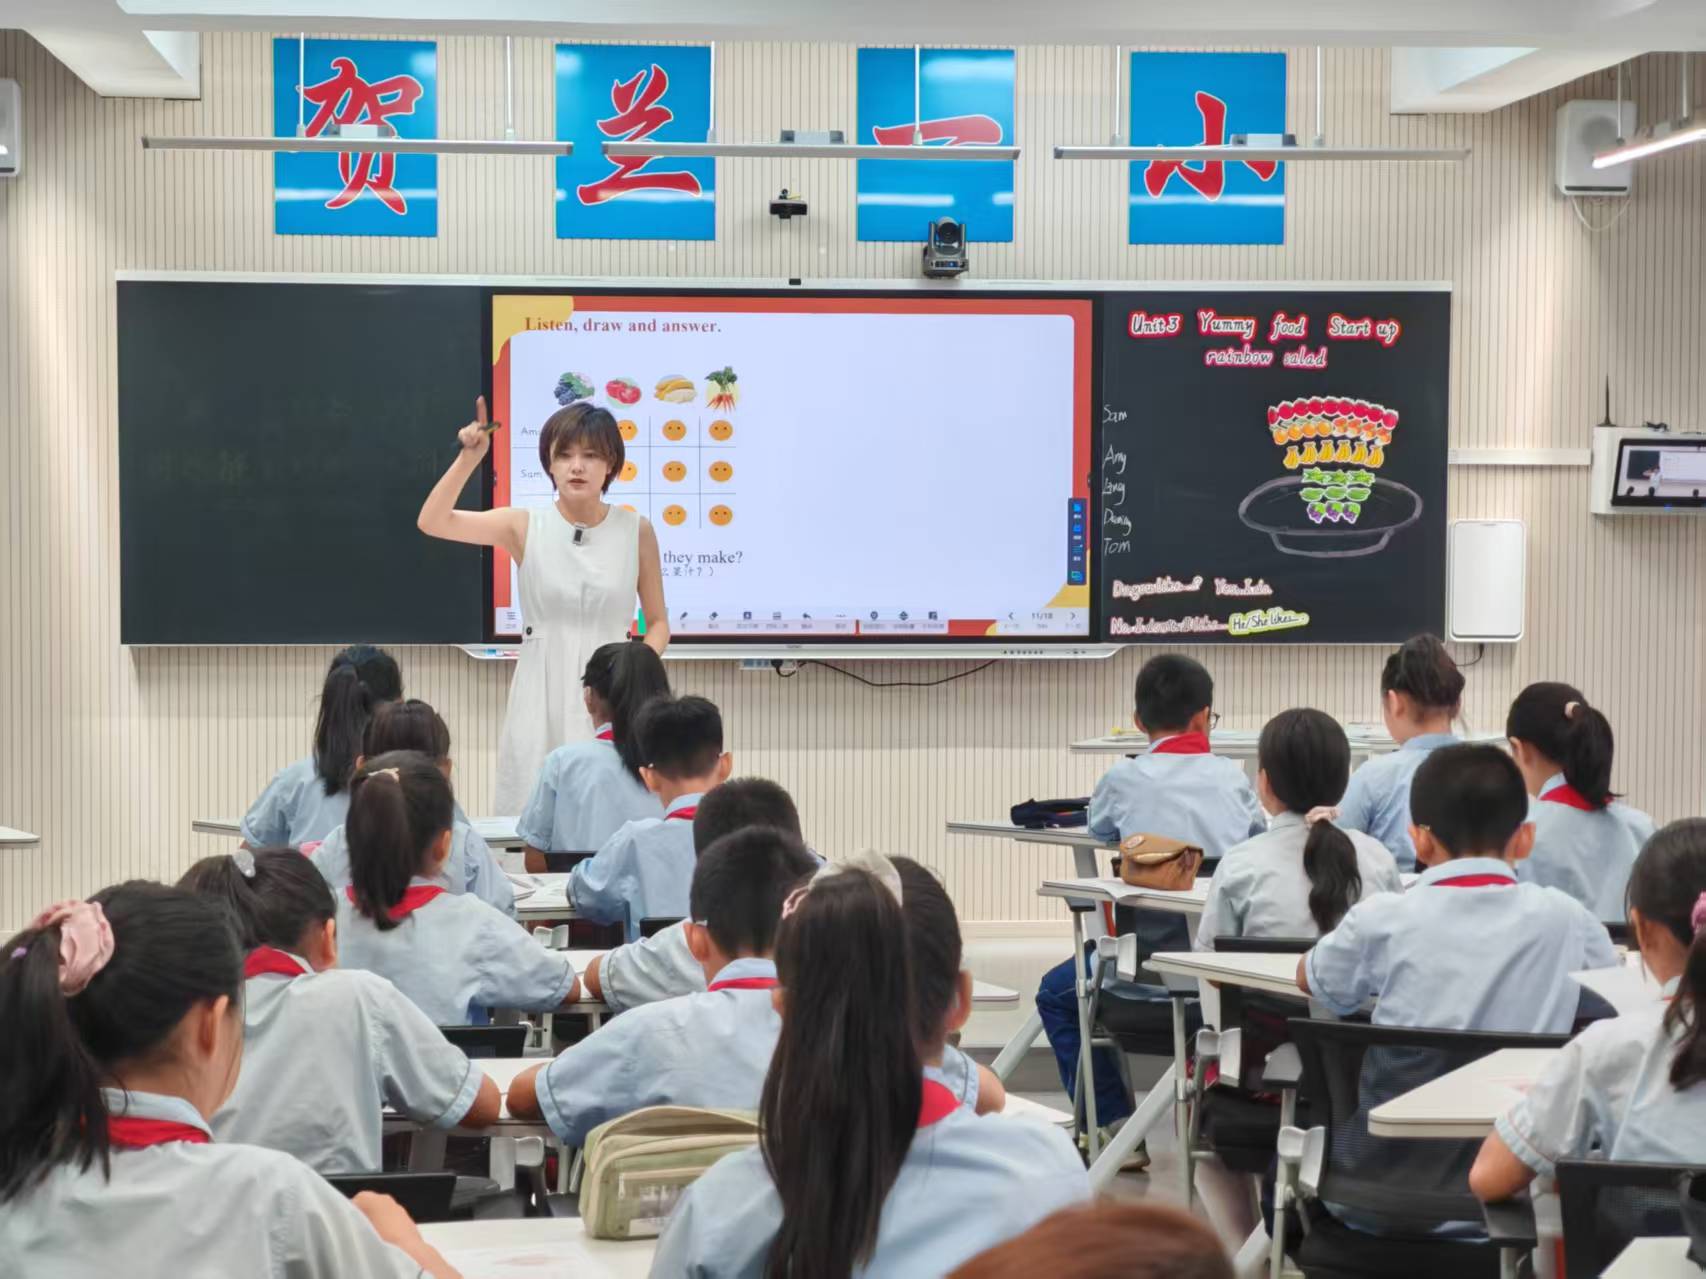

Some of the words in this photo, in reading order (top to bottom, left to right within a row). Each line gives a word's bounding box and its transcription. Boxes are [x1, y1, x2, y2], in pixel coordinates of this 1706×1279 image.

[295, 56, 425, 215] 贺
[577, 63, 703, 206] 兰
[525, 317, 578, 332] Listen,
[583, 317, 623, 331] draw
[628, 318, 657, 332] and
[662, 322, 721, 333] answer.
[1200, 312, 1254, 340] Yummy
[1271, 315, 1305, 340] food
[1329, 316, 1370, 336] Start
[1376, 321, 1399, 343] up
[1206, 344, 1273, 365] rainbow
[1283, 346, 1327, 367] salad
[1103, 404, 1128, 423] Sam
[521, 426, 540, 435] Am
[1103, 537, 1131, 556] Tom
[663, 550, 692, 568] they
[698, 550, 743, 564] make?
